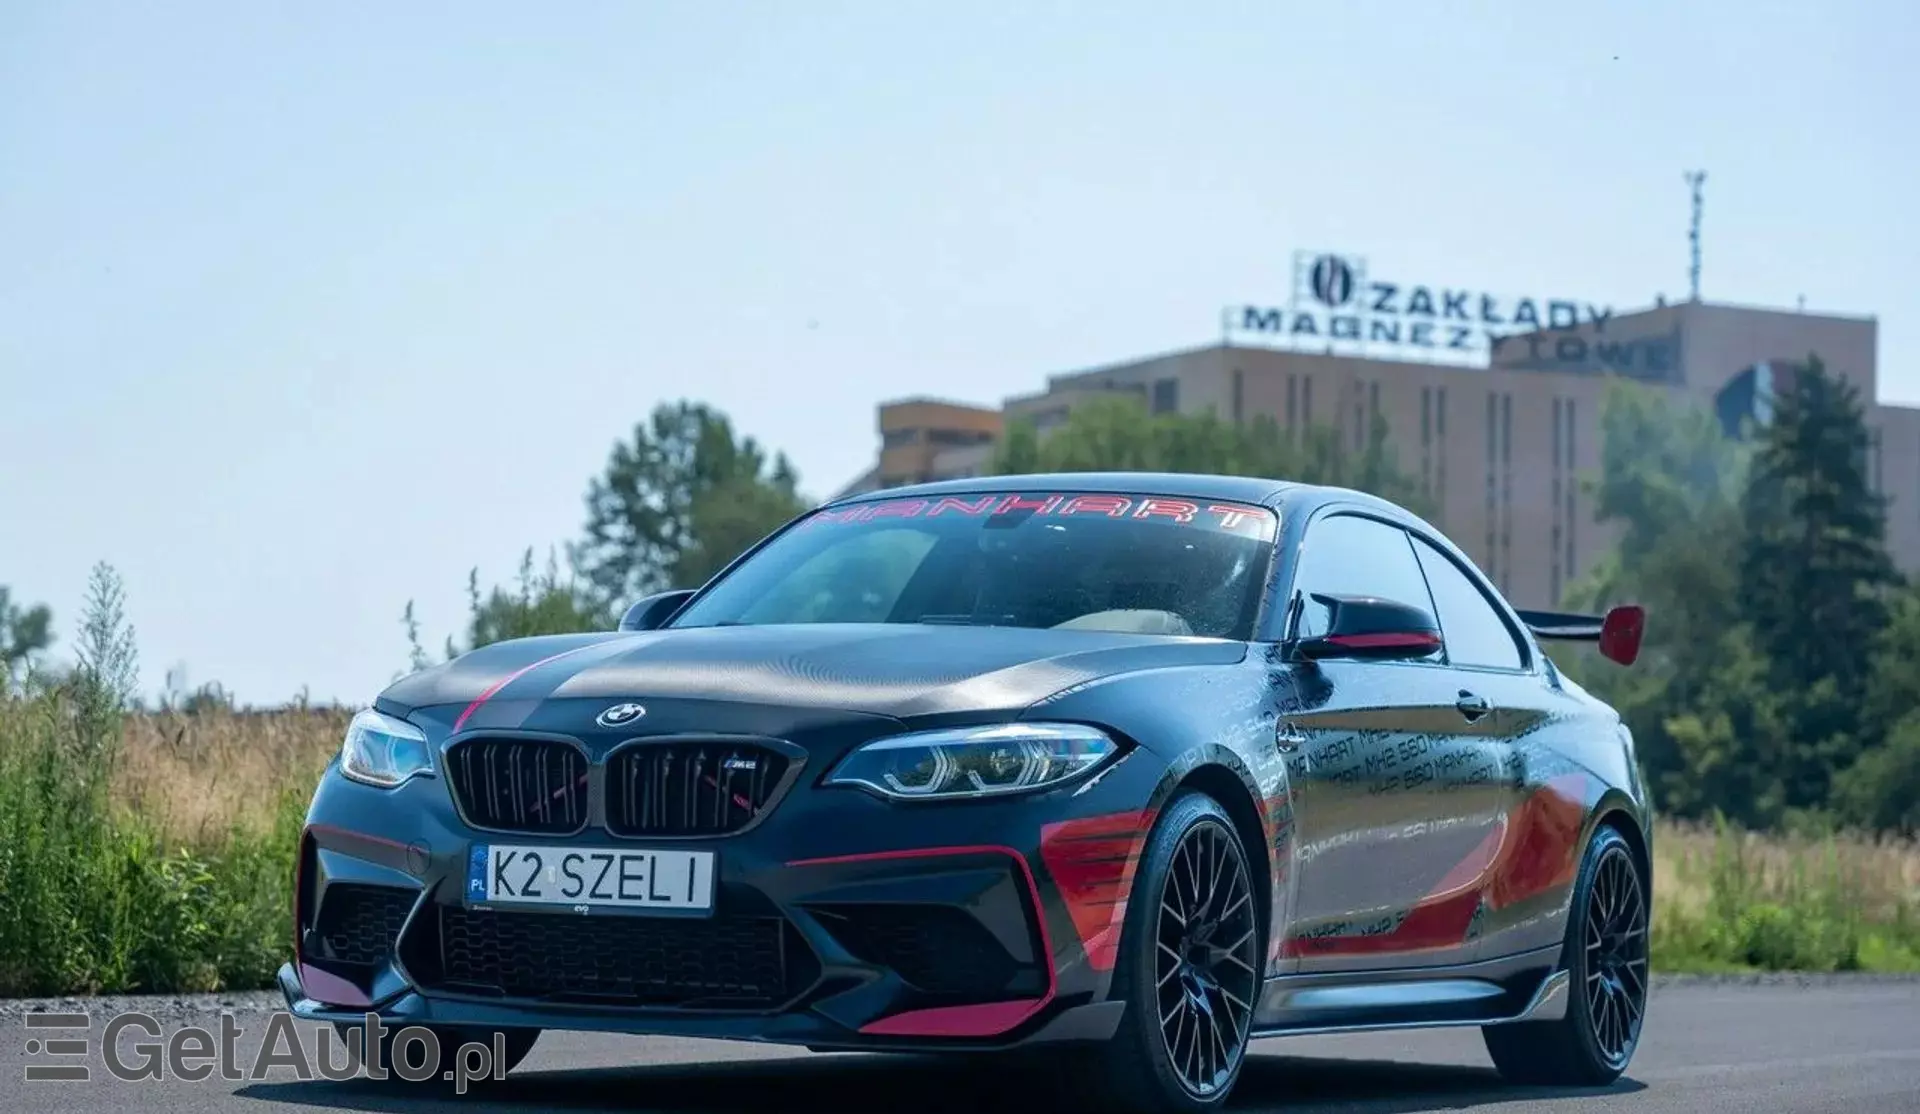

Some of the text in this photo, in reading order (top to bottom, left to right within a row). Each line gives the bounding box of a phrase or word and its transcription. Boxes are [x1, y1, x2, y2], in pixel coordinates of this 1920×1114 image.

[1371, 281, 1613, 333] ZAKŁADY
[800, 494, 1269, 529] MANHART
[471, 879, 485, 891] PL
[495, 850, 543, 897] K2
